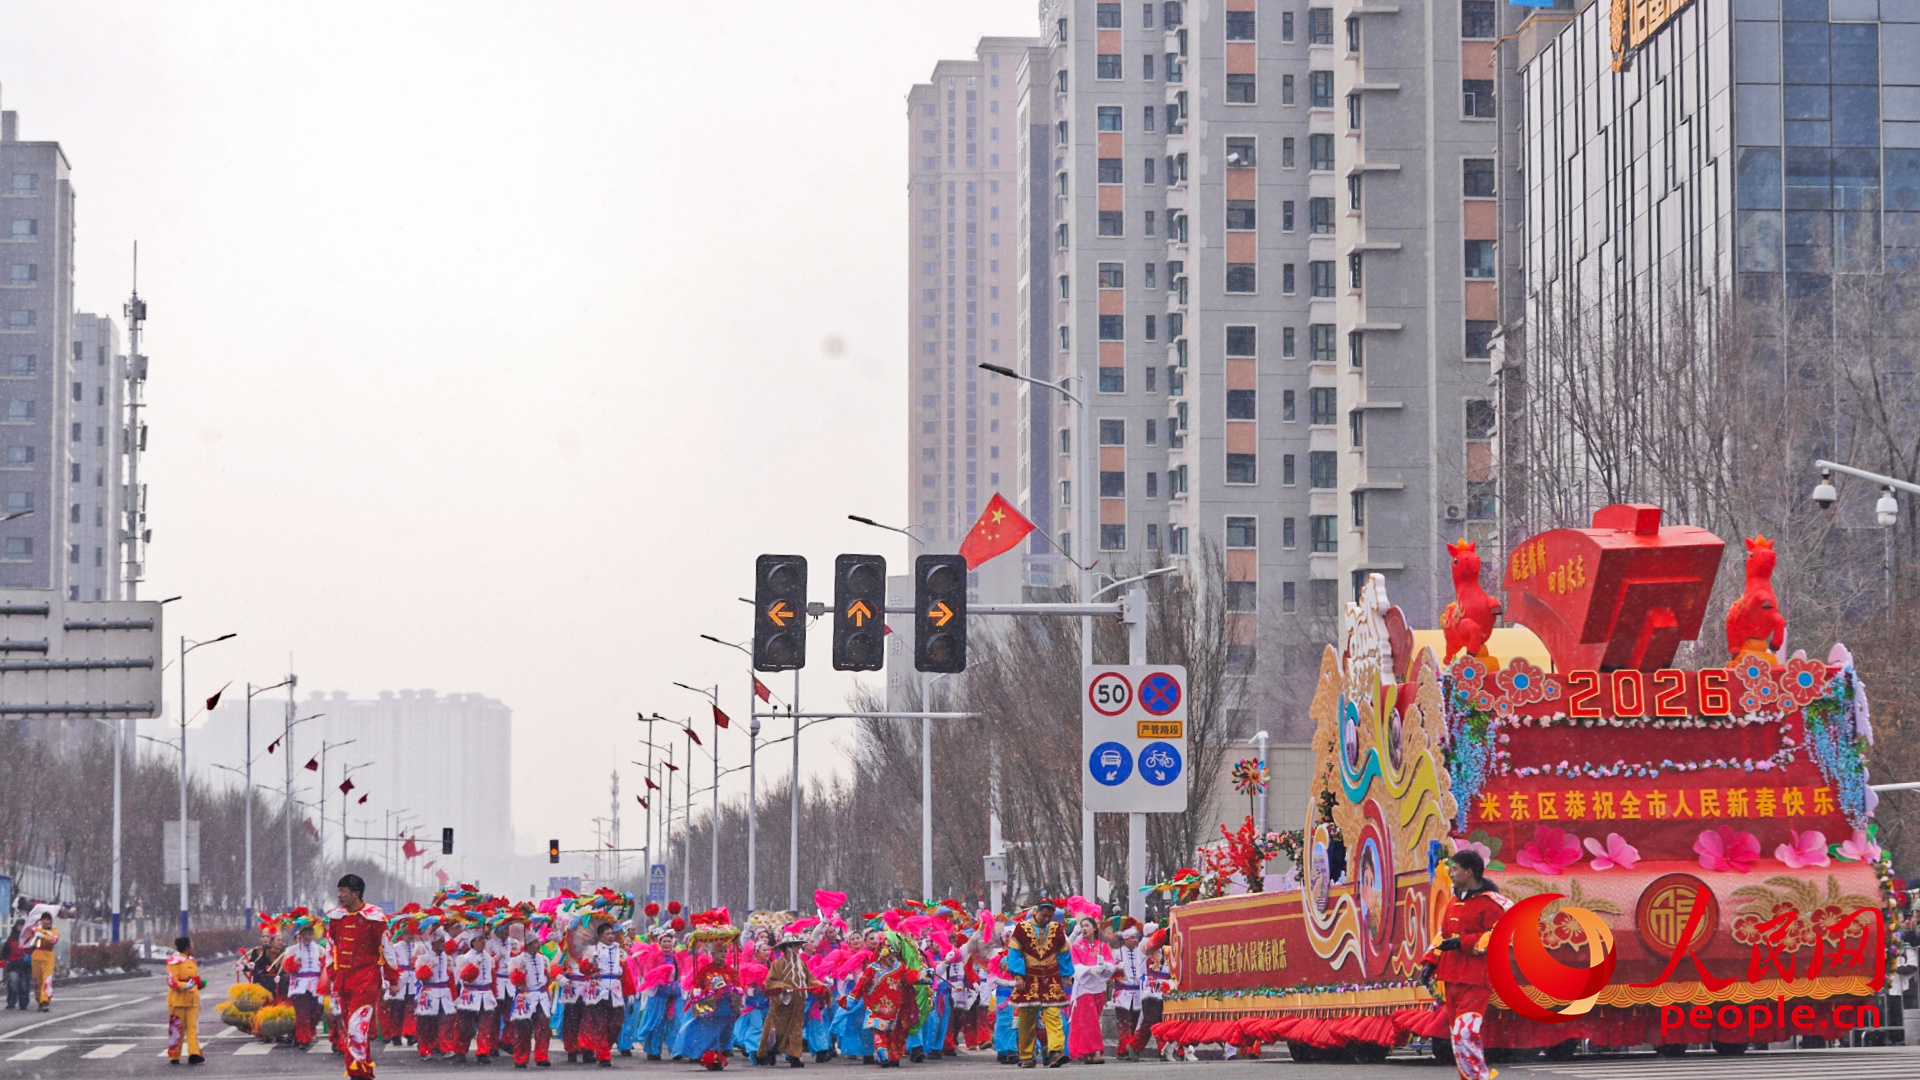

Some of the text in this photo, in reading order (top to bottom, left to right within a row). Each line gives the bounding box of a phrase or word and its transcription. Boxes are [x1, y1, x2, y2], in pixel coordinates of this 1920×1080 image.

[1098, 684, 1125, 704] 50
[1568, 668, 1731, 718] 2026
[1141, 724, 1179, 735] 严管路段
[1479, 787, 1836, 822] 米东区恭祝全市人民新春快乐
